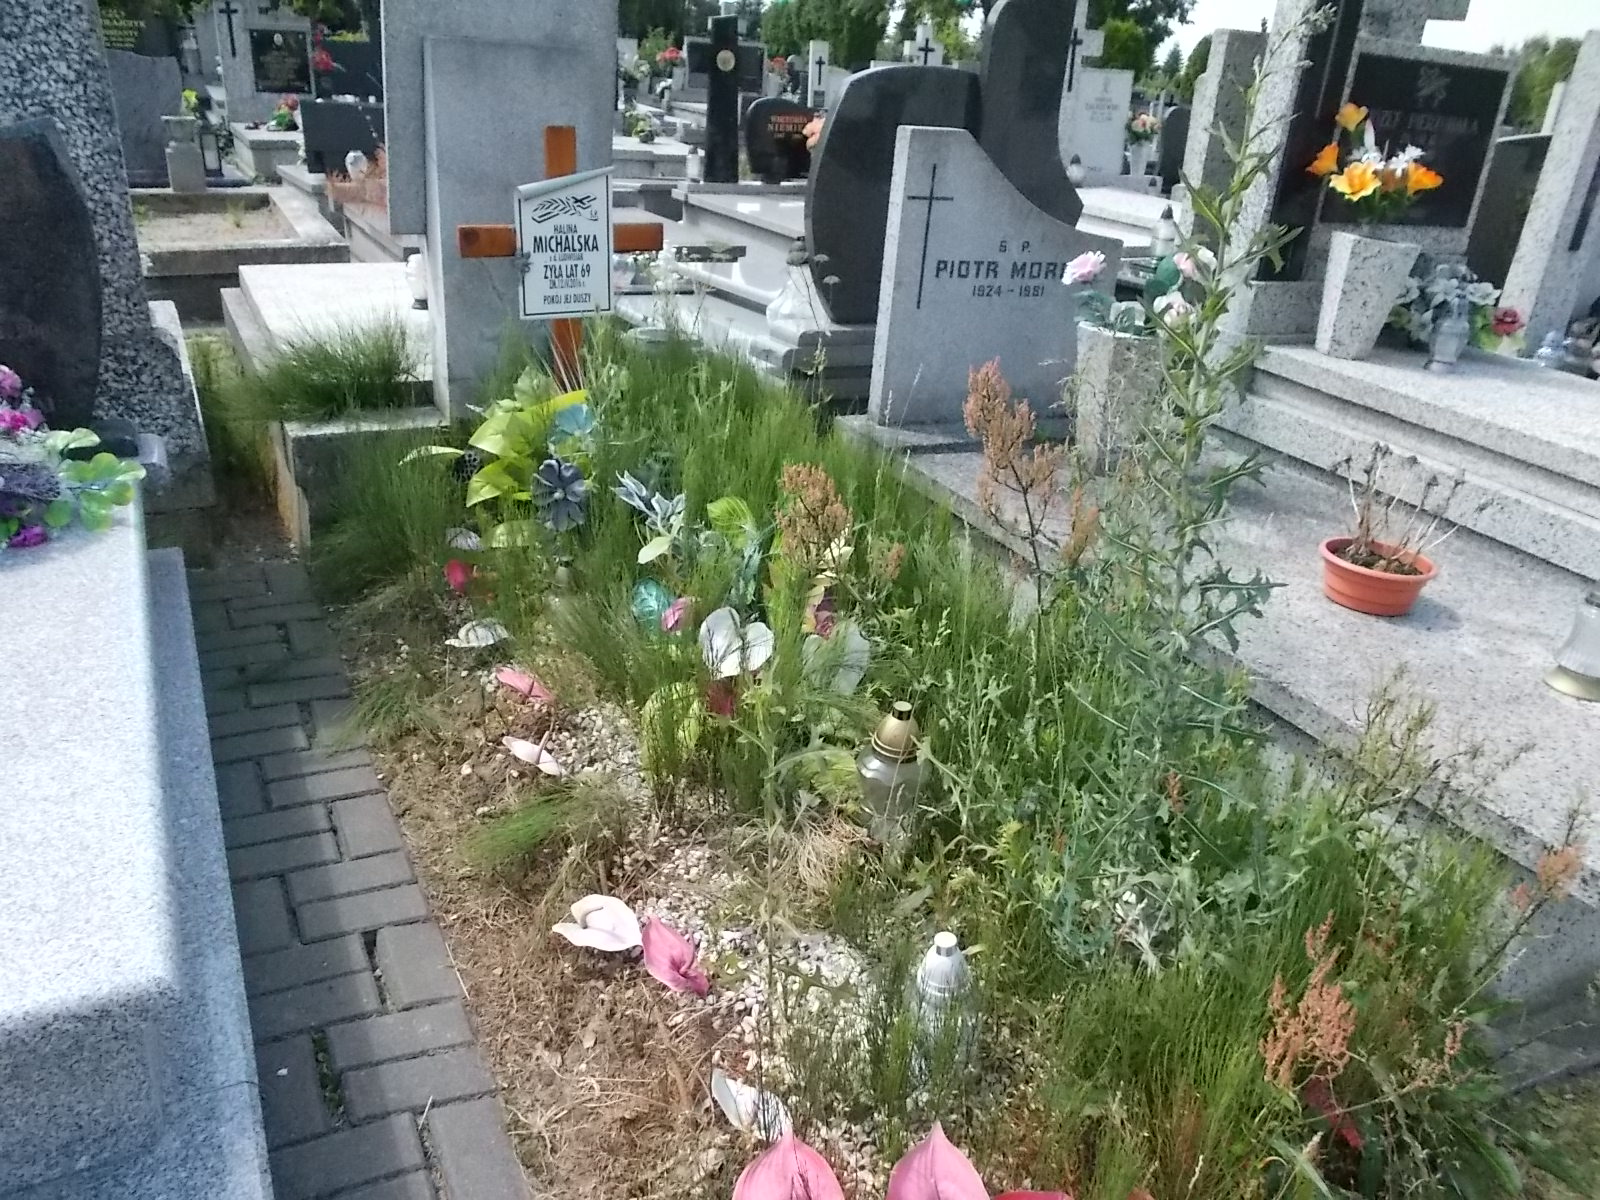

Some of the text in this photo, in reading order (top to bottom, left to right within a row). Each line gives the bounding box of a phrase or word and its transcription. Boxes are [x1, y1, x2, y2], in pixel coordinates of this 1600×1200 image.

[553, 224, 578, 234] HALINA
[533, 235, 599, 253] MICHALSKA
[565, 264, 578, 278] LAT
[580, 264, 590, 278] 69
[935, 260, 999, 279] PIOTR
[972, 285, 1001, 297] 1924
[573, 293, 591, 303] DUSZY
